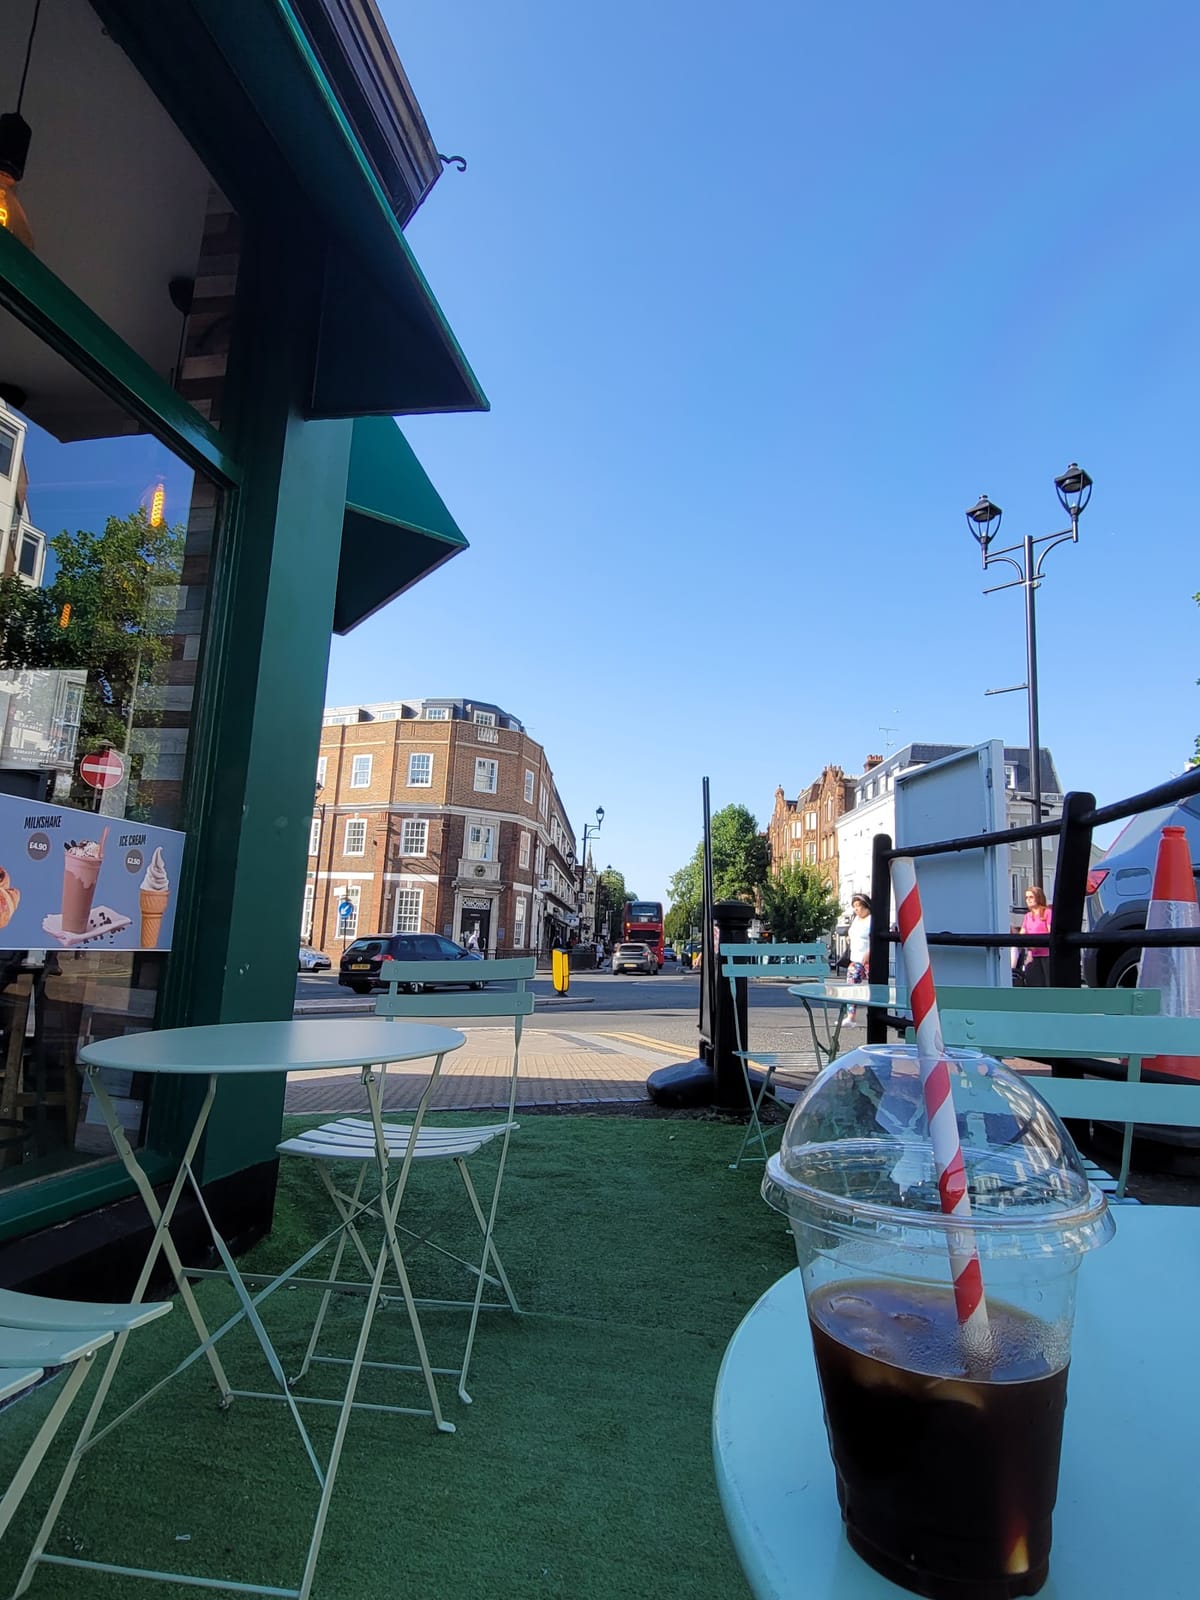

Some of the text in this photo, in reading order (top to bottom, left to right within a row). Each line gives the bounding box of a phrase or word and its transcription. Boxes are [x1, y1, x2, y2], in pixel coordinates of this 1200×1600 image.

[24, 816, 62, 829] MILKSHAKE
[29, 841, 48, 851] £4.90
[119, 834, 146, 847] ICE CREAM
